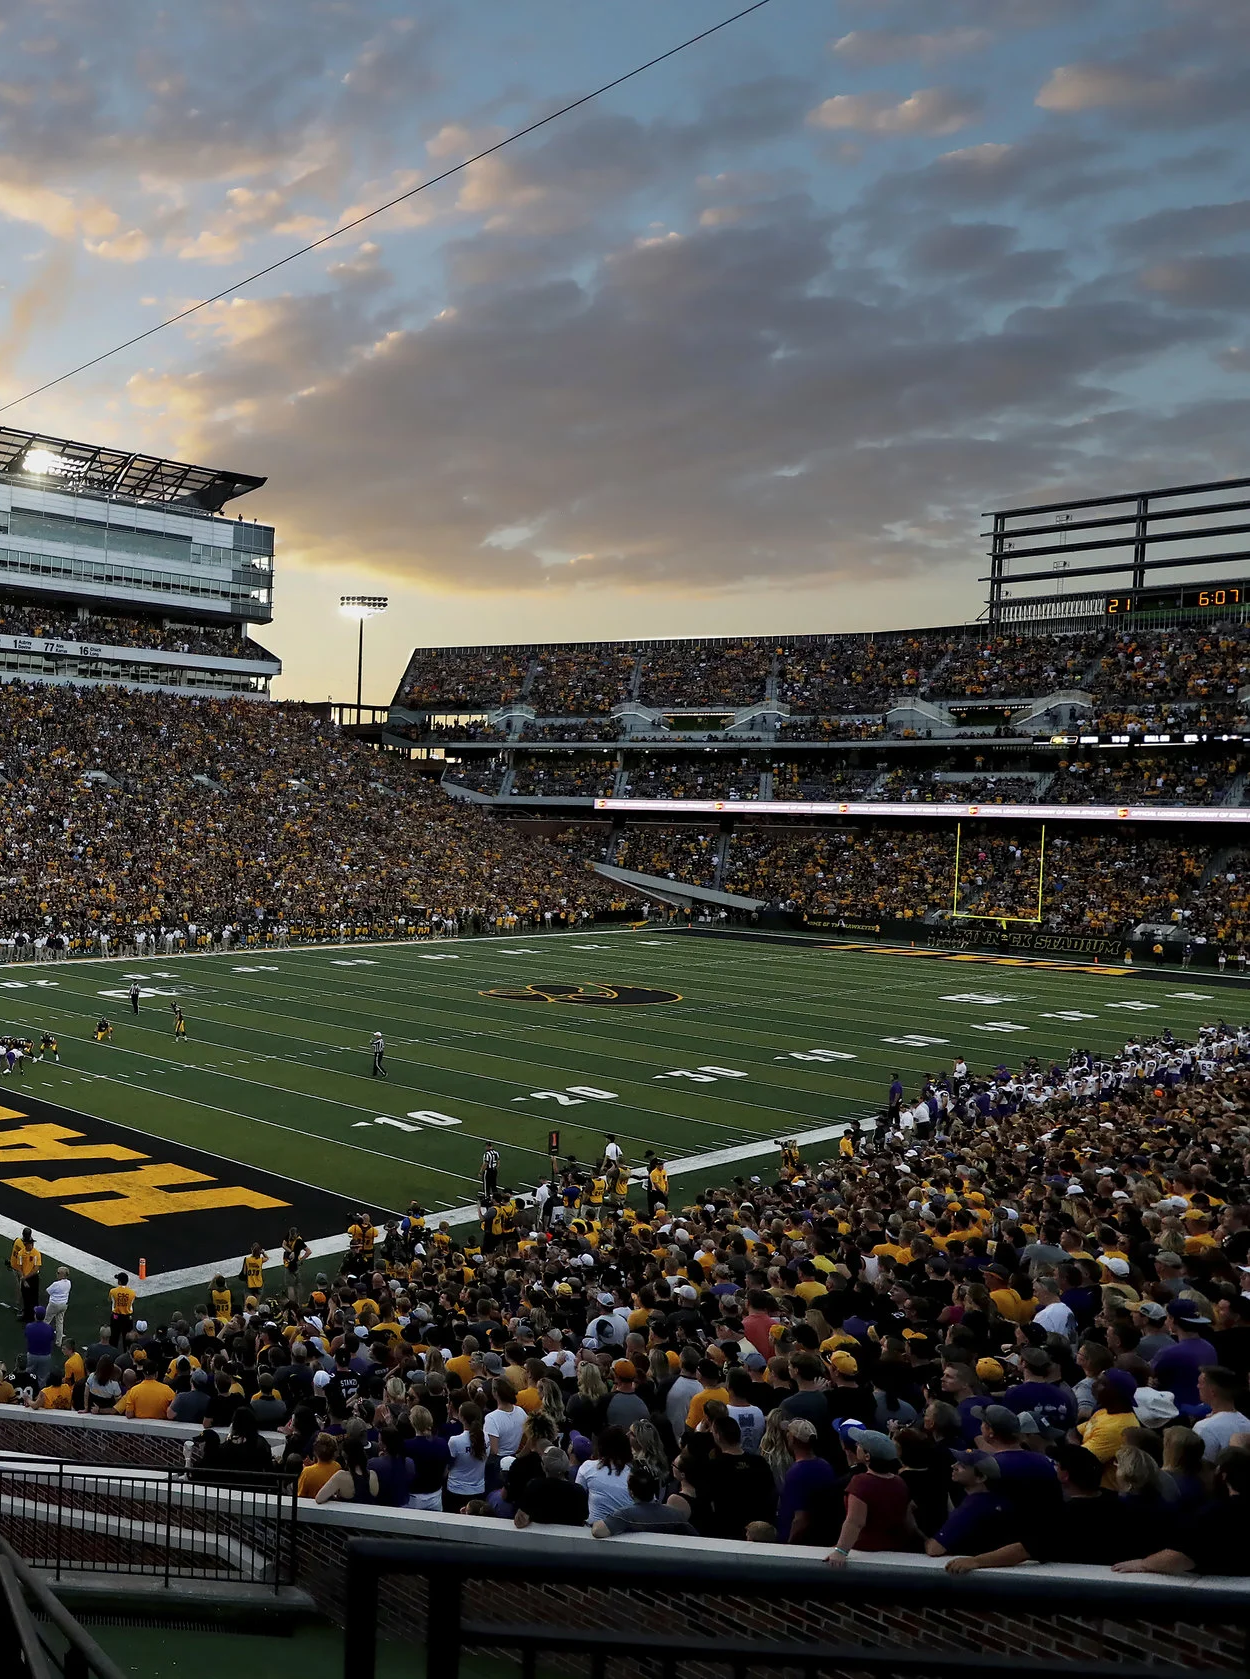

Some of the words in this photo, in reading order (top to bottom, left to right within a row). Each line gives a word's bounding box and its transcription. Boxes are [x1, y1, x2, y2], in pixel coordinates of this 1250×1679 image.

[1199, 589, 1239, 606] 6:07
[13, 640, 18, 648] 1
[44, 642, 54, 652] 77
[79, 646, 89, 655] 16
[959, 929, 1033, 948] KINNCK
[1034, 935, 1121, 955] STADIUM
[788, 1049, 859, 1063] 40
[664, 1065, 750, 1083] 30
[530, 1086, 619, 1106] 20
[374, 1110, 463, 1132] 10
[552, 1133, 557, 1147] 1
